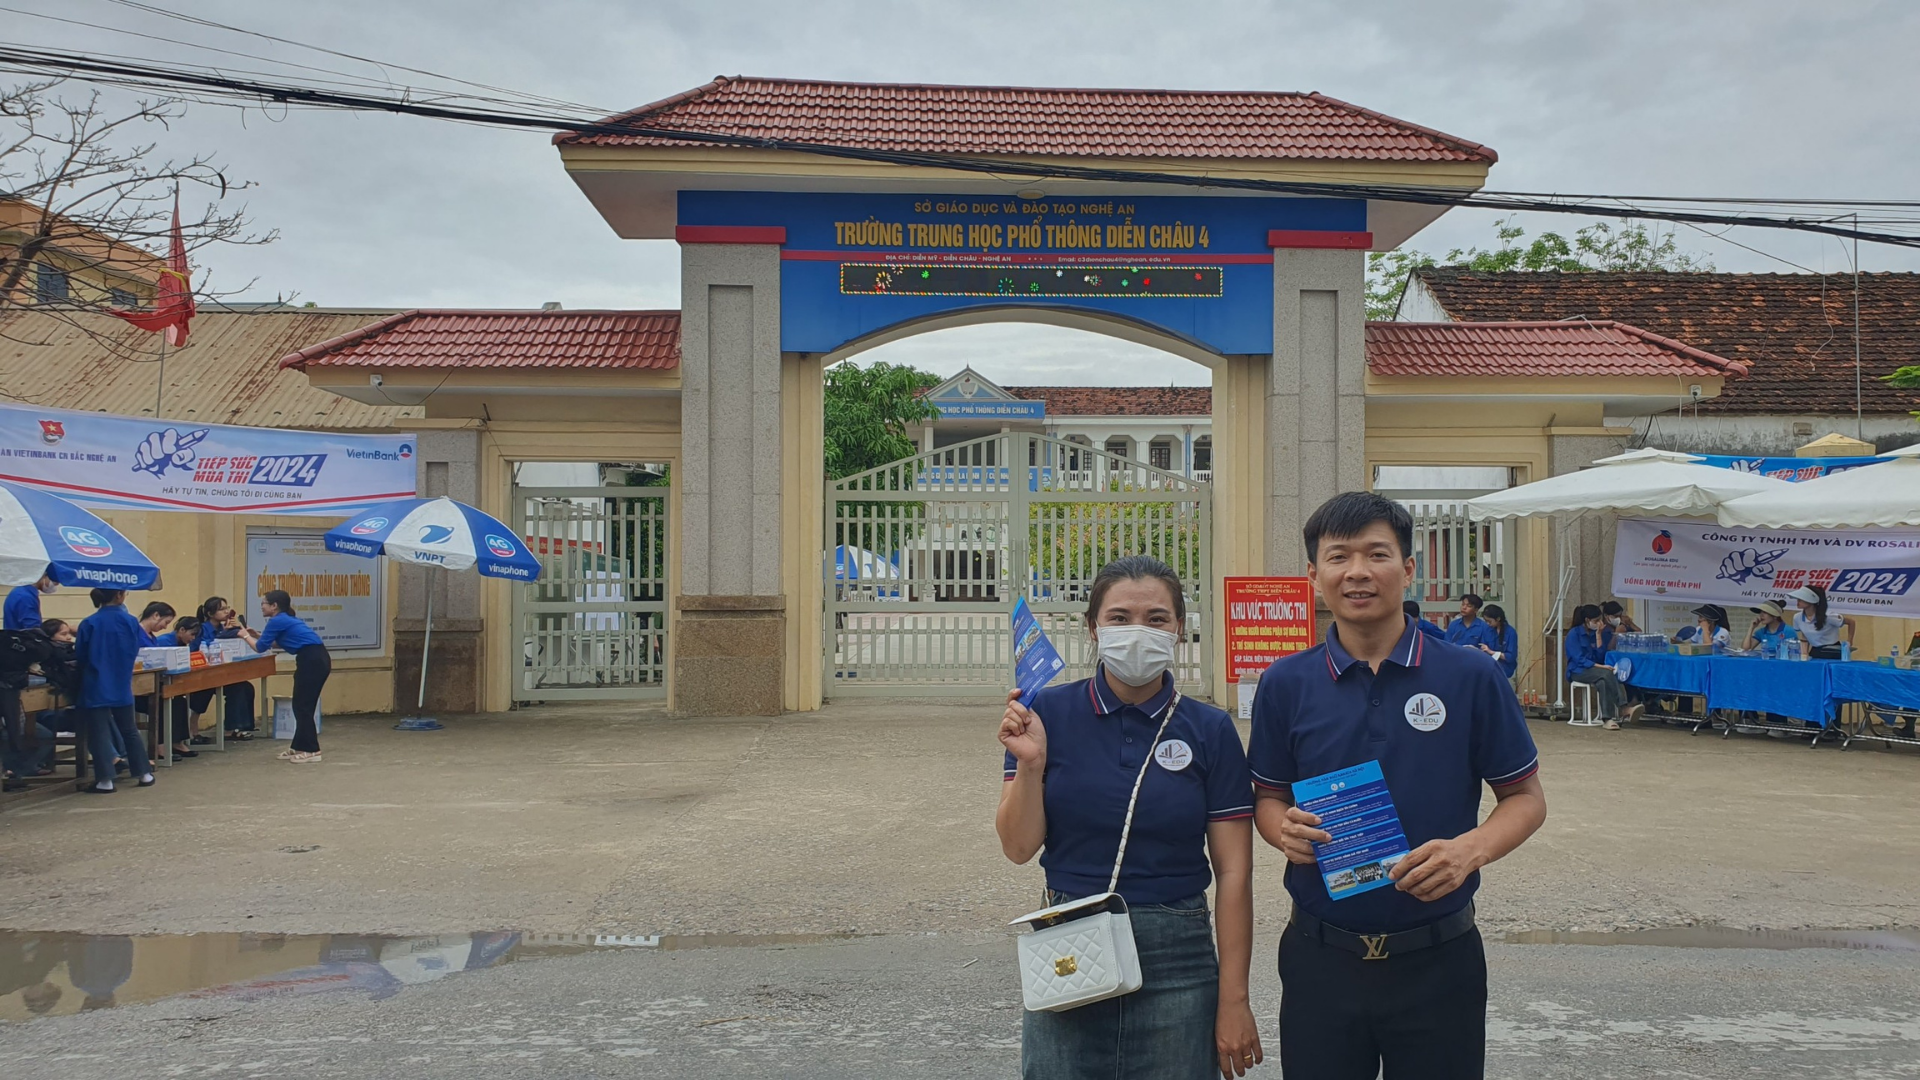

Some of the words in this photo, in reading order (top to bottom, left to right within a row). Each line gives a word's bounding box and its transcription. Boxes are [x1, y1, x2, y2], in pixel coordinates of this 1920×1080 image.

[915, 200, 931, 213] SỞ
[936, 200, 968, 214] GIÁO
[972, 203, 999, 217] DỤC
[1003, 201, 1018, 214] VÀ
[1022, 201, 1048, 214] ĐÀO
[1052, 203, 1076, 217] TẠO
[1080, 201, 1114, 217] NGHỆ
[1117, 204, 1135, 215] AN
[834, 215, 903, 246] TRƯỜNG
[907, 223, 963, 248] TRUNG
[968, 224, 1002, 252] HỌC
[1007, 215, 1042, 248] PHỔ
[1045, 219, 1101, 249] THÔNG
[1106, 216, 1146, 249] DIỄN
[1149, 220, 1195, 249] CHÂU
[1198, 225, 1210, 248] 4
[948, 406, 960, 416] HỌC
[976, 405, 996, 414] THÔNG
[1012, 404, 1029, 414] CHÂU
[14, 448, 56, 460] VIETINBANK
[58, 452, 68, 460] CN
[86, 454, 104, 463] NGHỆ
[107, 455, 117, 463] AN
[346, 448, 400, 462] VietinBank
[197, 455, 228, 470] TIẾP
[229, 454, 258, 470] SỨC
[253, 456, 316, 484] 2024
[226, 471, 250, 484] THI
[182, 487, 193, 496] TỰ
[286, 492, 302, 500] BẠN
[363, 520, 384, 528] 4G
[66, 531, 100, 546] 4G
[489, 538, 508, 549] 4G
[1702, 532, 1738, 542] CÔNG
[1759, 536, 1796, 545] TNHH
[1800, 538, 1820, 546] TM
[1824, 537, 1842, 547] VÀ
[1845, 540, 1865, 548] DV
[335, 539, 372, 554] vinaphone
[414, 551, 446, 564] VNPT
[74, 566, 138, 584] vinaphone
[488, 563, 529, 577] vinaphone
[305, 575, 314, 597] AN
[316, 570, 332, 597] TOÀN
[334, 574, 348, 597] GIAO
[350, 570, 370, 597] THÔNG
[1688, 581, 1702, 590] PHÍ
[1776, 568, 1806, 580] TIẾP
[1808, 568, 1839, 580] SỨC
[1836, 572, 1907, 594] 2024
[1230, 602, 1246, 620] KHU
[1247, 598, 1262, 624] VỰC
[1263, 596, 1294, 620] TRƯỜNG
[1294, 602, 1307, 620] THI
[1231, 627, 1235, 636] 1.
[1232, 642, 1236, 650] 2.
